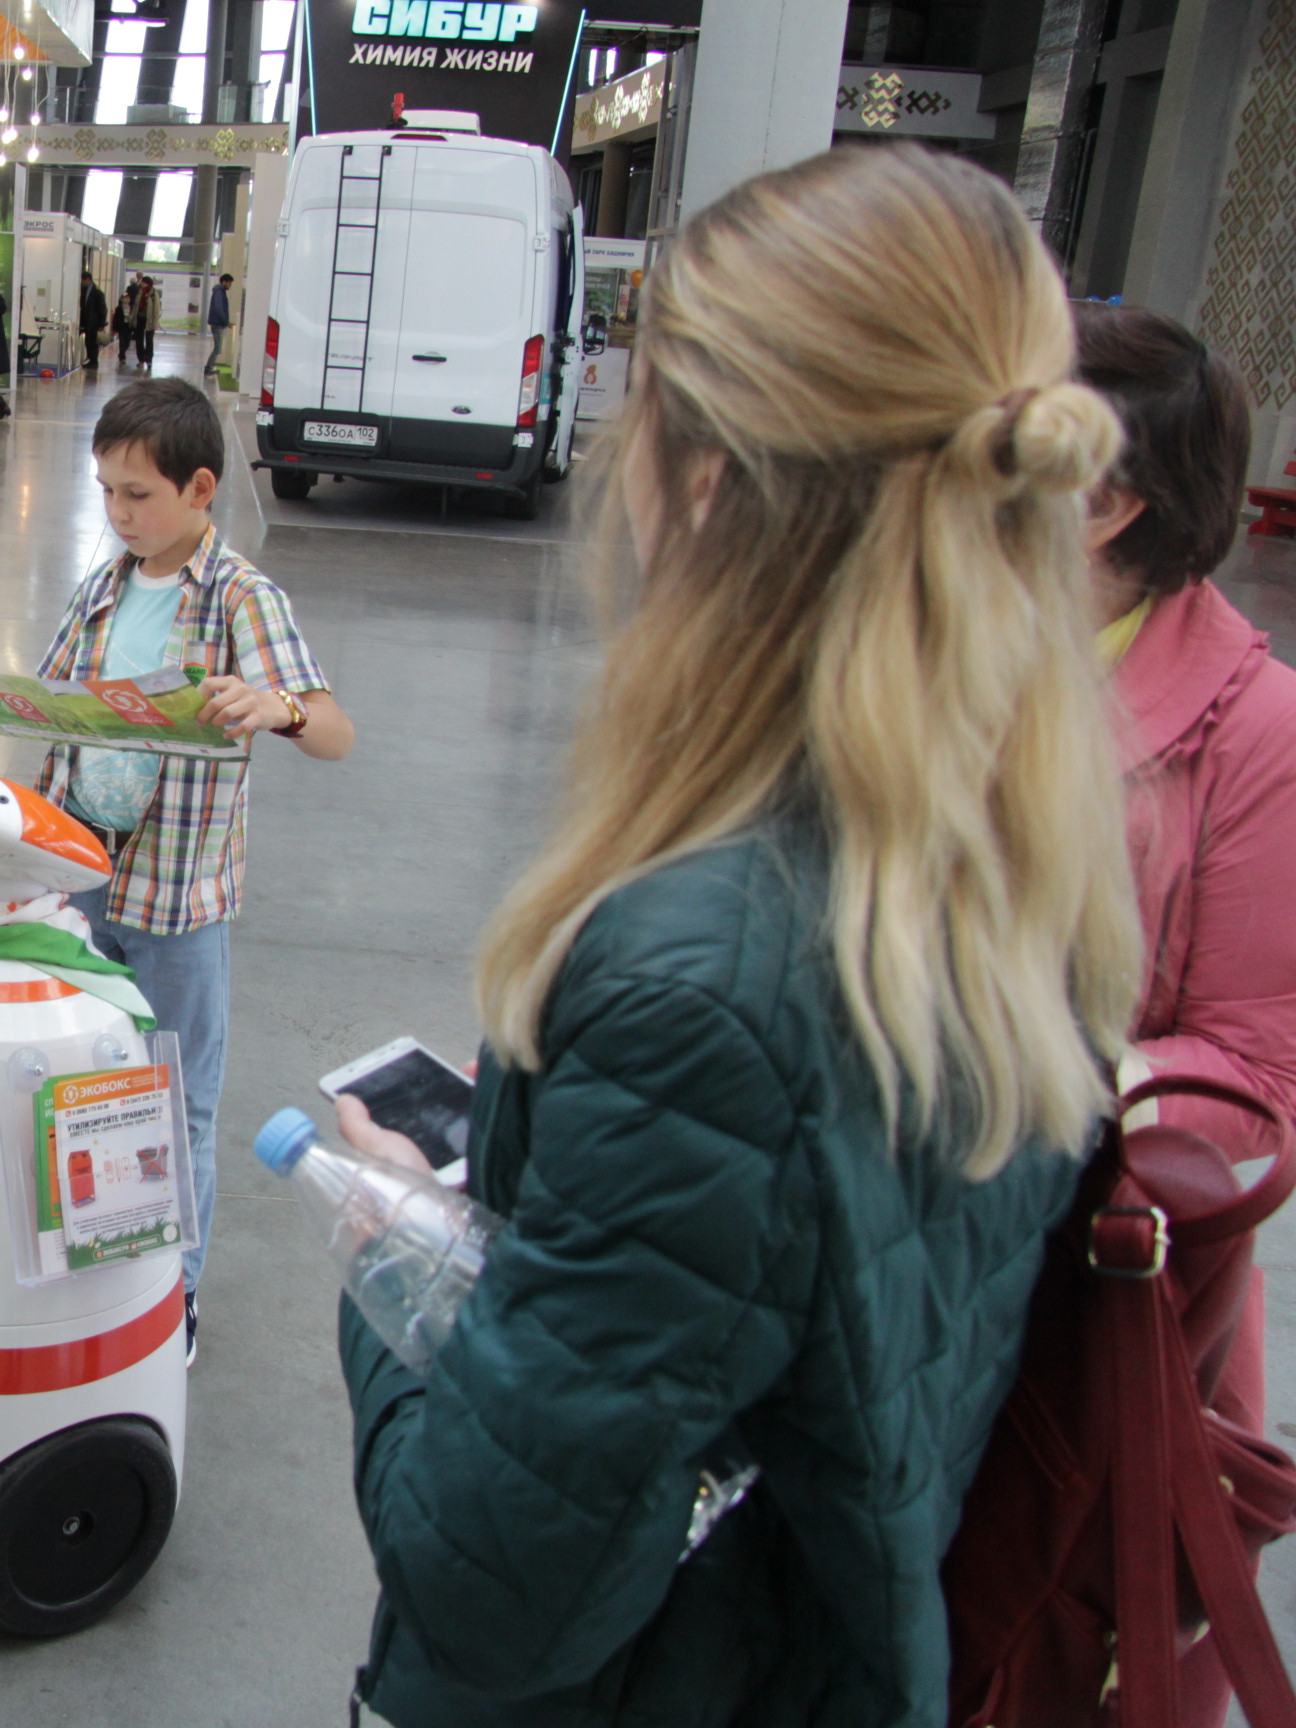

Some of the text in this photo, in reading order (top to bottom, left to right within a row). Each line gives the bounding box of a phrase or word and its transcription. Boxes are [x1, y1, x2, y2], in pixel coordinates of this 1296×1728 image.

[352, 0, 538, 42] СИБУР
[349, 43, 534, 73] ХИМИЯ ЖИЗНИ
[24, 220, 55, 228] ЭКРОС
[357, 426, 374, 438] 102
[79, 1078, 132, 1098] ЭКОБОКС
[67, 1114, 119, 1132] УТИЛИЗИРУЙТЕ
